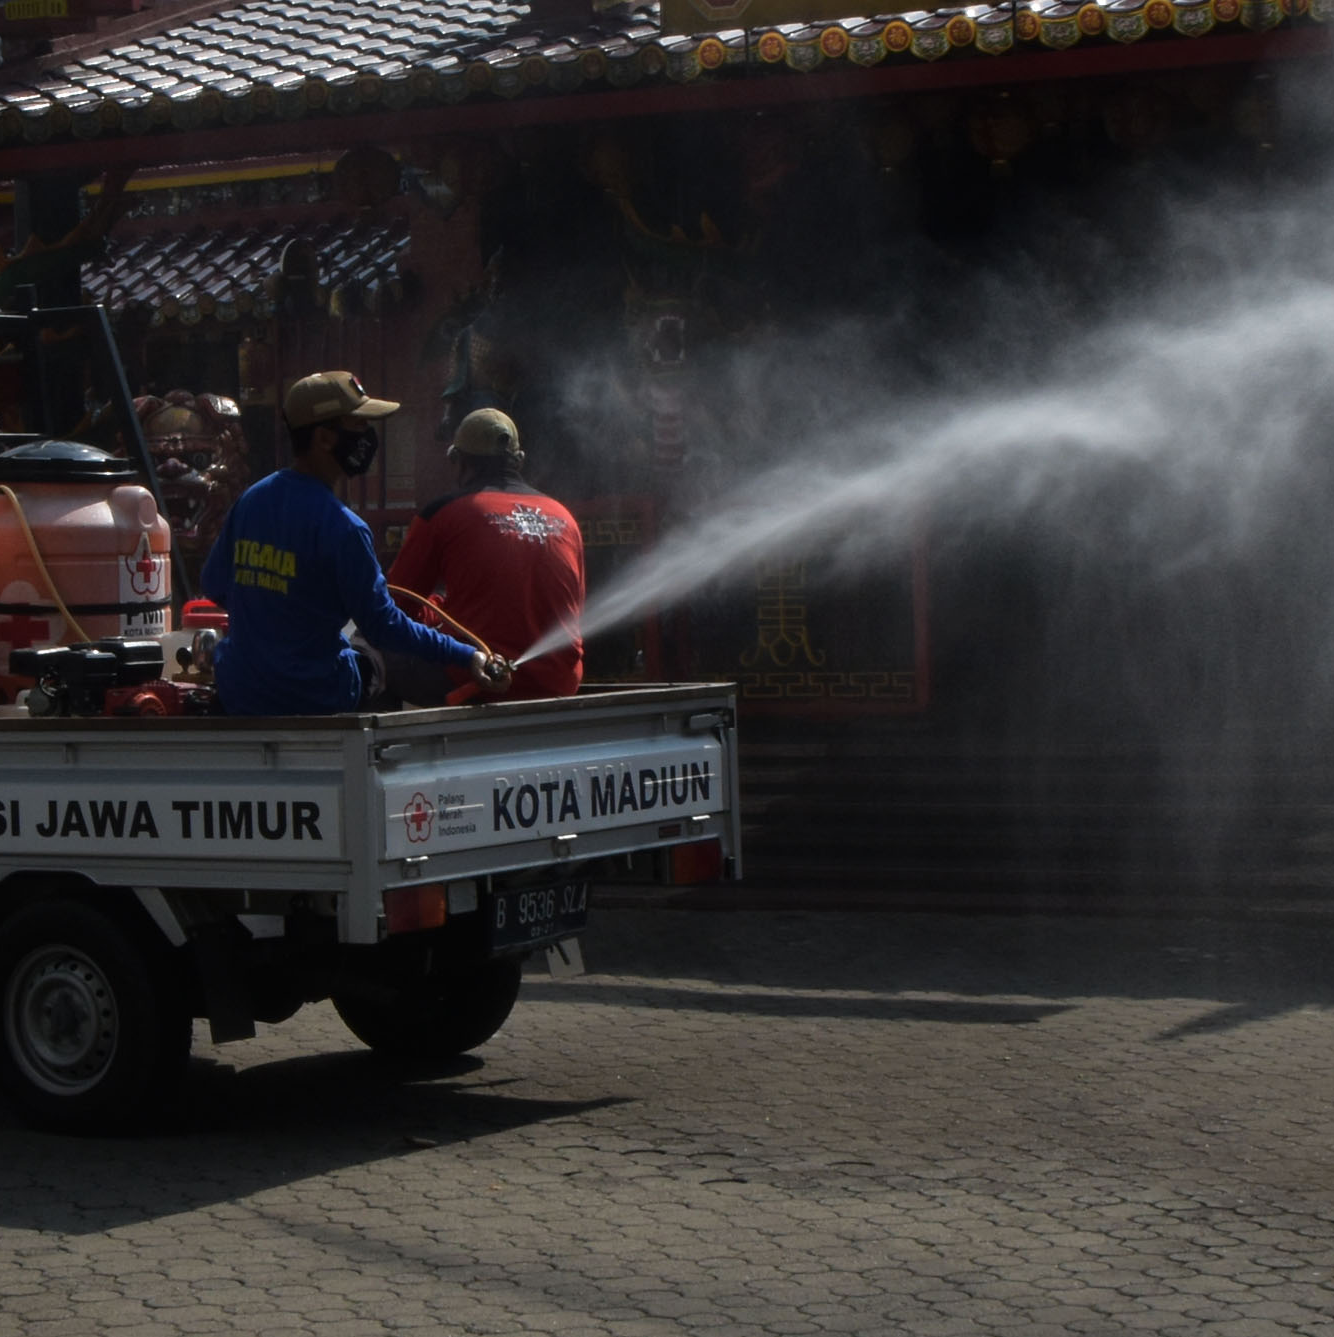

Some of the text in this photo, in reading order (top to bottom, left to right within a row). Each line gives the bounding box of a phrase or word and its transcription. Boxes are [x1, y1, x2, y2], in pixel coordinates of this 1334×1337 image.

[437, 792, 466, 807] Palang
[492, 760, 711, 832] KOTA MADIUN
[35, 799, 160, 839] JAWA
[171, 800, 323, 841] TIMUR
[438, 822, 477, 838] Indonesia
[496, 881, 588, 929] B 9536 SLA
